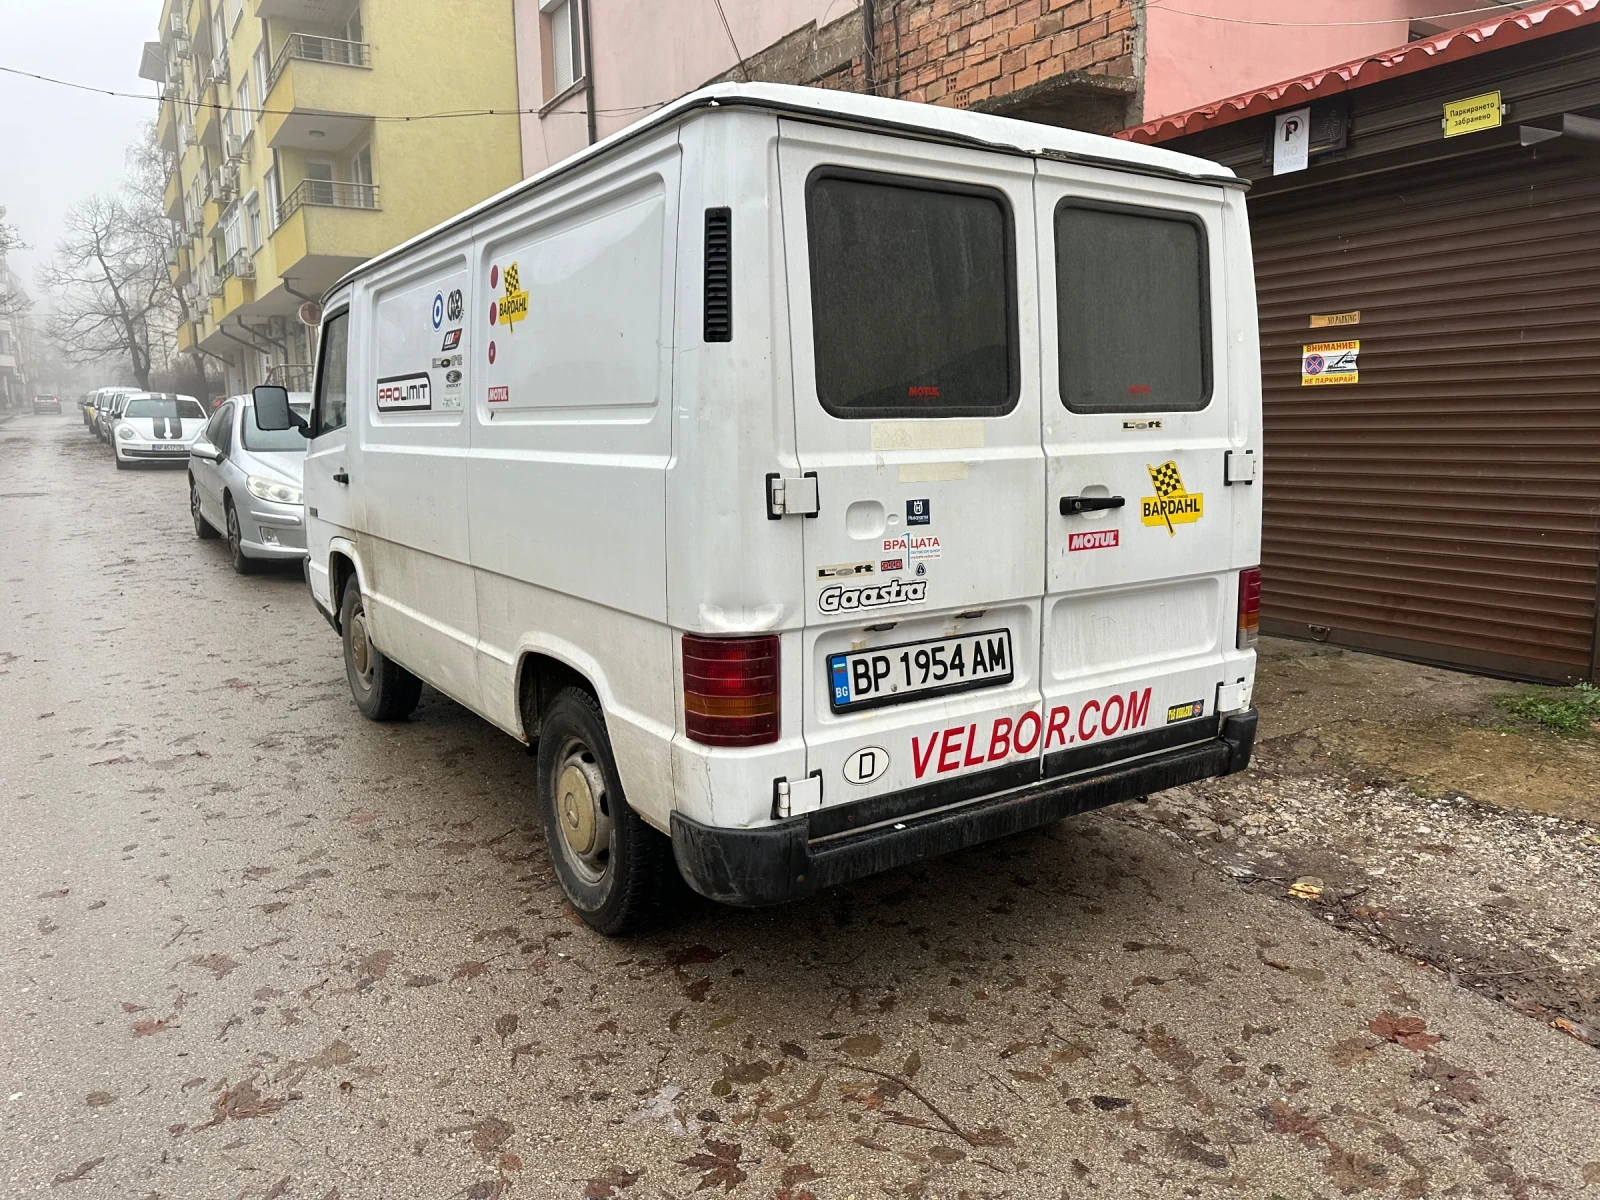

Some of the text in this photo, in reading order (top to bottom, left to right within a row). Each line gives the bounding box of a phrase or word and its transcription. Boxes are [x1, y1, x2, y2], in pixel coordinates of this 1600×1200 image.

[1450, 102, 1495, 117] Паркирането
[1454, 113, 1491, 127] забранено
[1283, 145, 1298, 158] NO
[499, 297, 527, 317] BARDAHL
[1327, 313, 1357, 325] NO PARKING
[1306, 341, 1356, 353] ВНИМАНИЕ!
[1315, 374, 1356, 384] ПАРКИРАЙ!
[379, 383, 428, 402] PROLIMIT
[489, 387, 508, 401] MOTUL
[908, 386, 940, 397] MOTUL
[1123, 420, 1162, 430] Loft
[1143, 498, 1200, 517] BARDAHL
[1071, 531, 1117, 550] MOTUL
[818, 564, 874, 578] Loft
[818, 579, 927, 612] Gaastra
[835, 637, 1006, 698] BG BP 1954 AM
[911, 687, 1152, 779] VELBOR.COM
[858, 752, 875, 779] D
